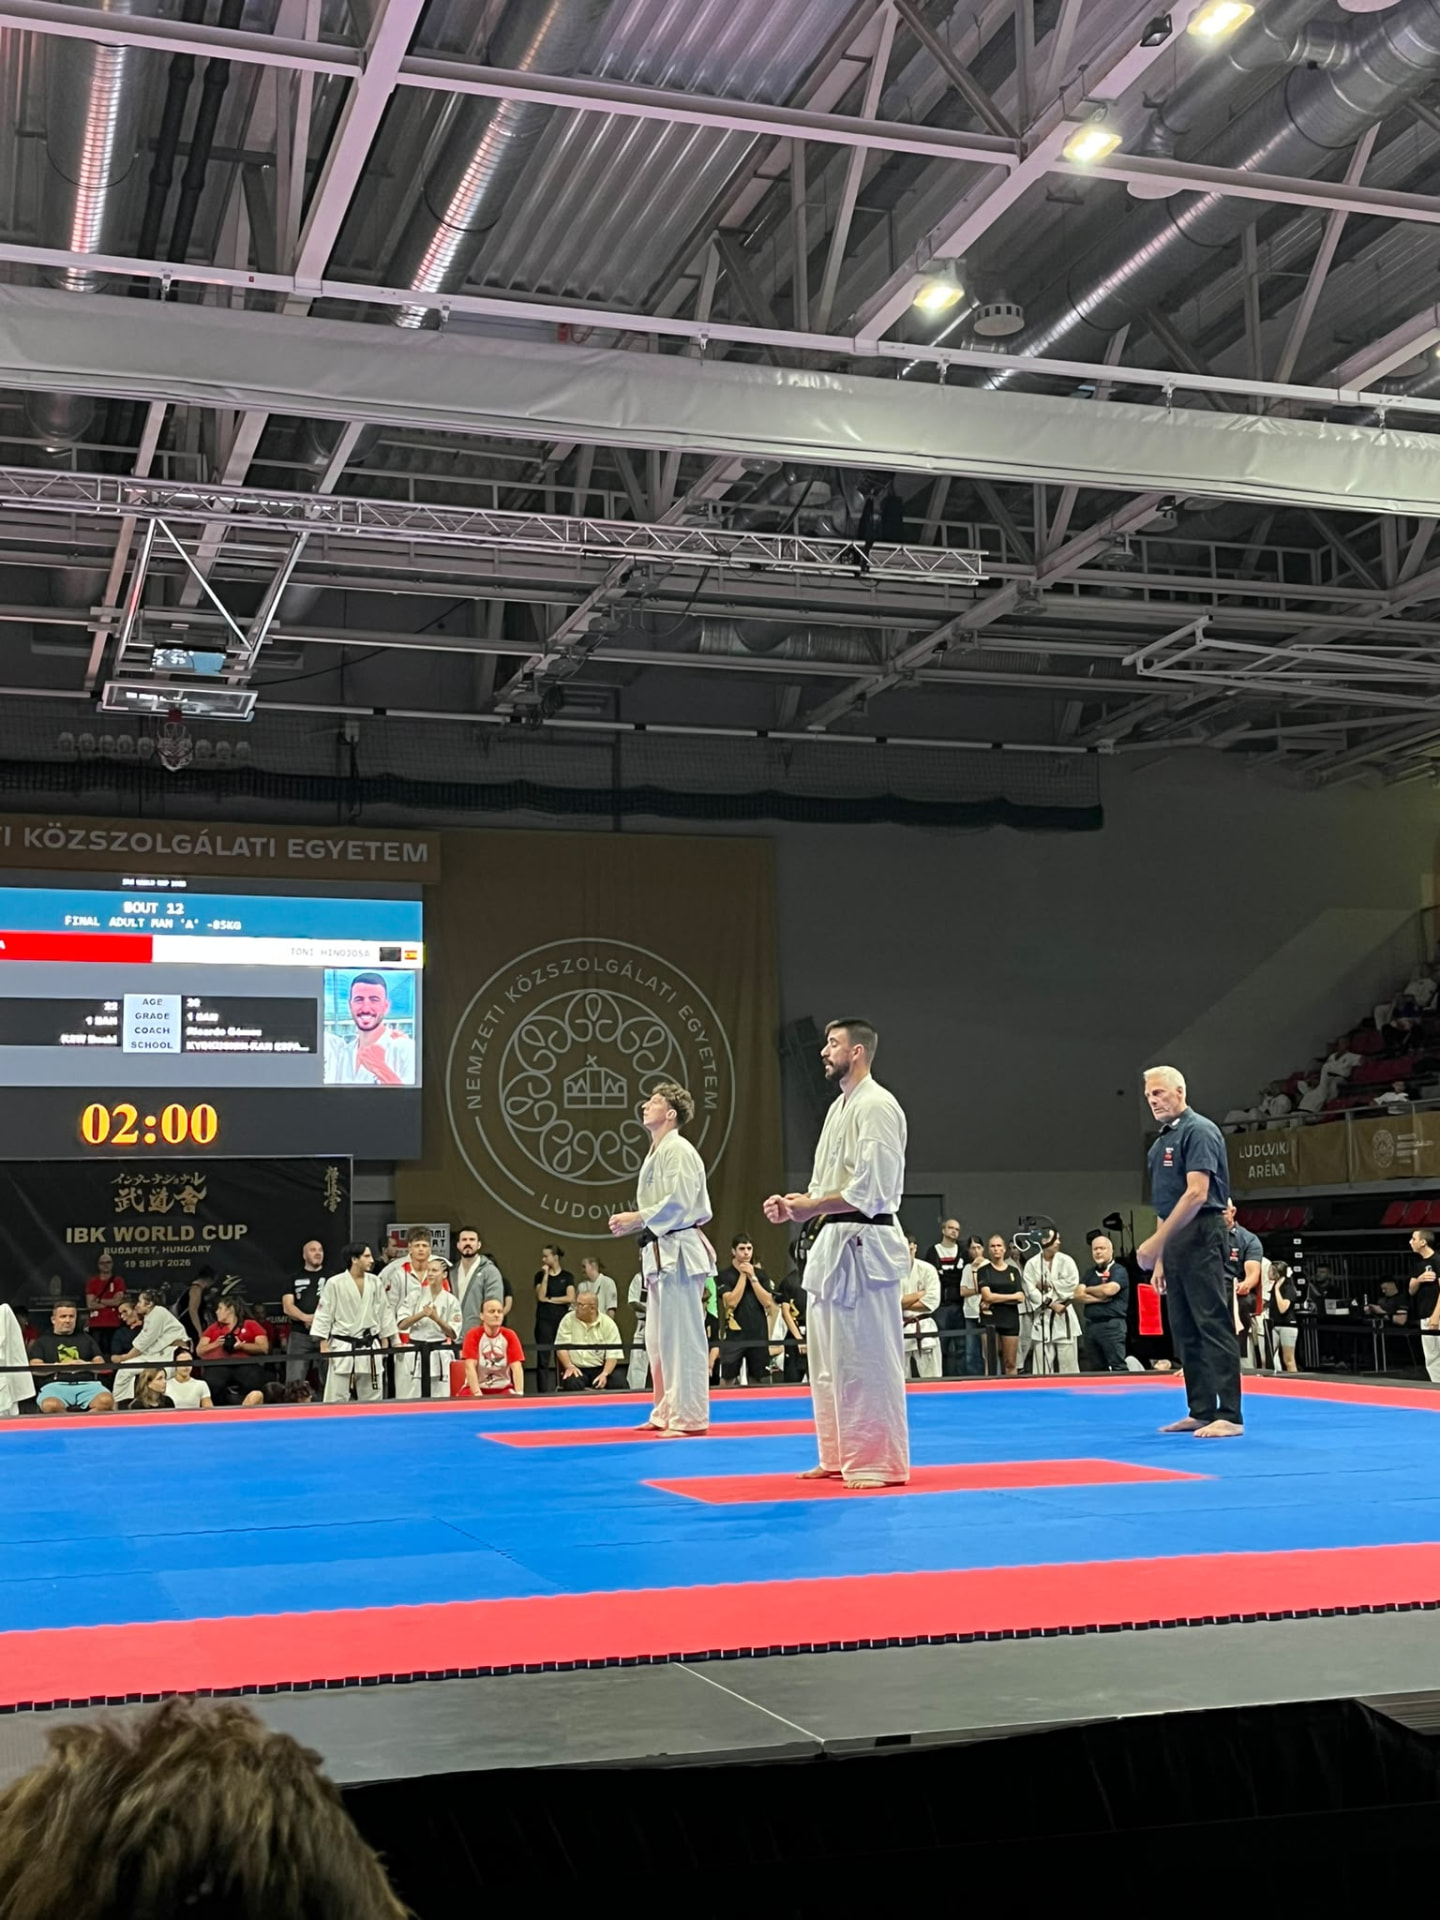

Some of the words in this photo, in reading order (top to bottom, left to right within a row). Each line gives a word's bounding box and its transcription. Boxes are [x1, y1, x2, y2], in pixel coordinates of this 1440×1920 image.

[0, 826, 11, 847] I
[24, 822, 275, 857] KÖZSZOLGÁLATI
[288, 838, 427, 862] EGYETEM
[123, 901, 159, 914] BOUT
[166, 902, 184, 915] 12
[64, 915, 100, 927] FINAL
[108, 916, 145, 928] ADULT
[151, 918, 173, 929] MAN
[135, 1012, 170, 1020] GRADE
[465, 1004, 505, 1110] NEMZETI
[504, 957, 677, 1002] KÖZSZOLGÁLATI
[677, 1003, 718, 1110] EGYETEM
[131, 1041, 173, 1049] SCHOOL
[81, 1102, 219, 1146] 02:00
[1248, 1160, 1286, 1178] ARÉNA
[540, 1194, 637, 1219] LUDOVIK
[66, 1226, 106, 1244] IBK
[113, 1225, 195, 1242] WORLD
[202, 1224, 248, 1241] CUP
[103, 1246, 160, 1255] BUDAPEST,
[162, 1245, 211, 1254] HUNGARY
[138, 1260, 164, 1268] SEPT
